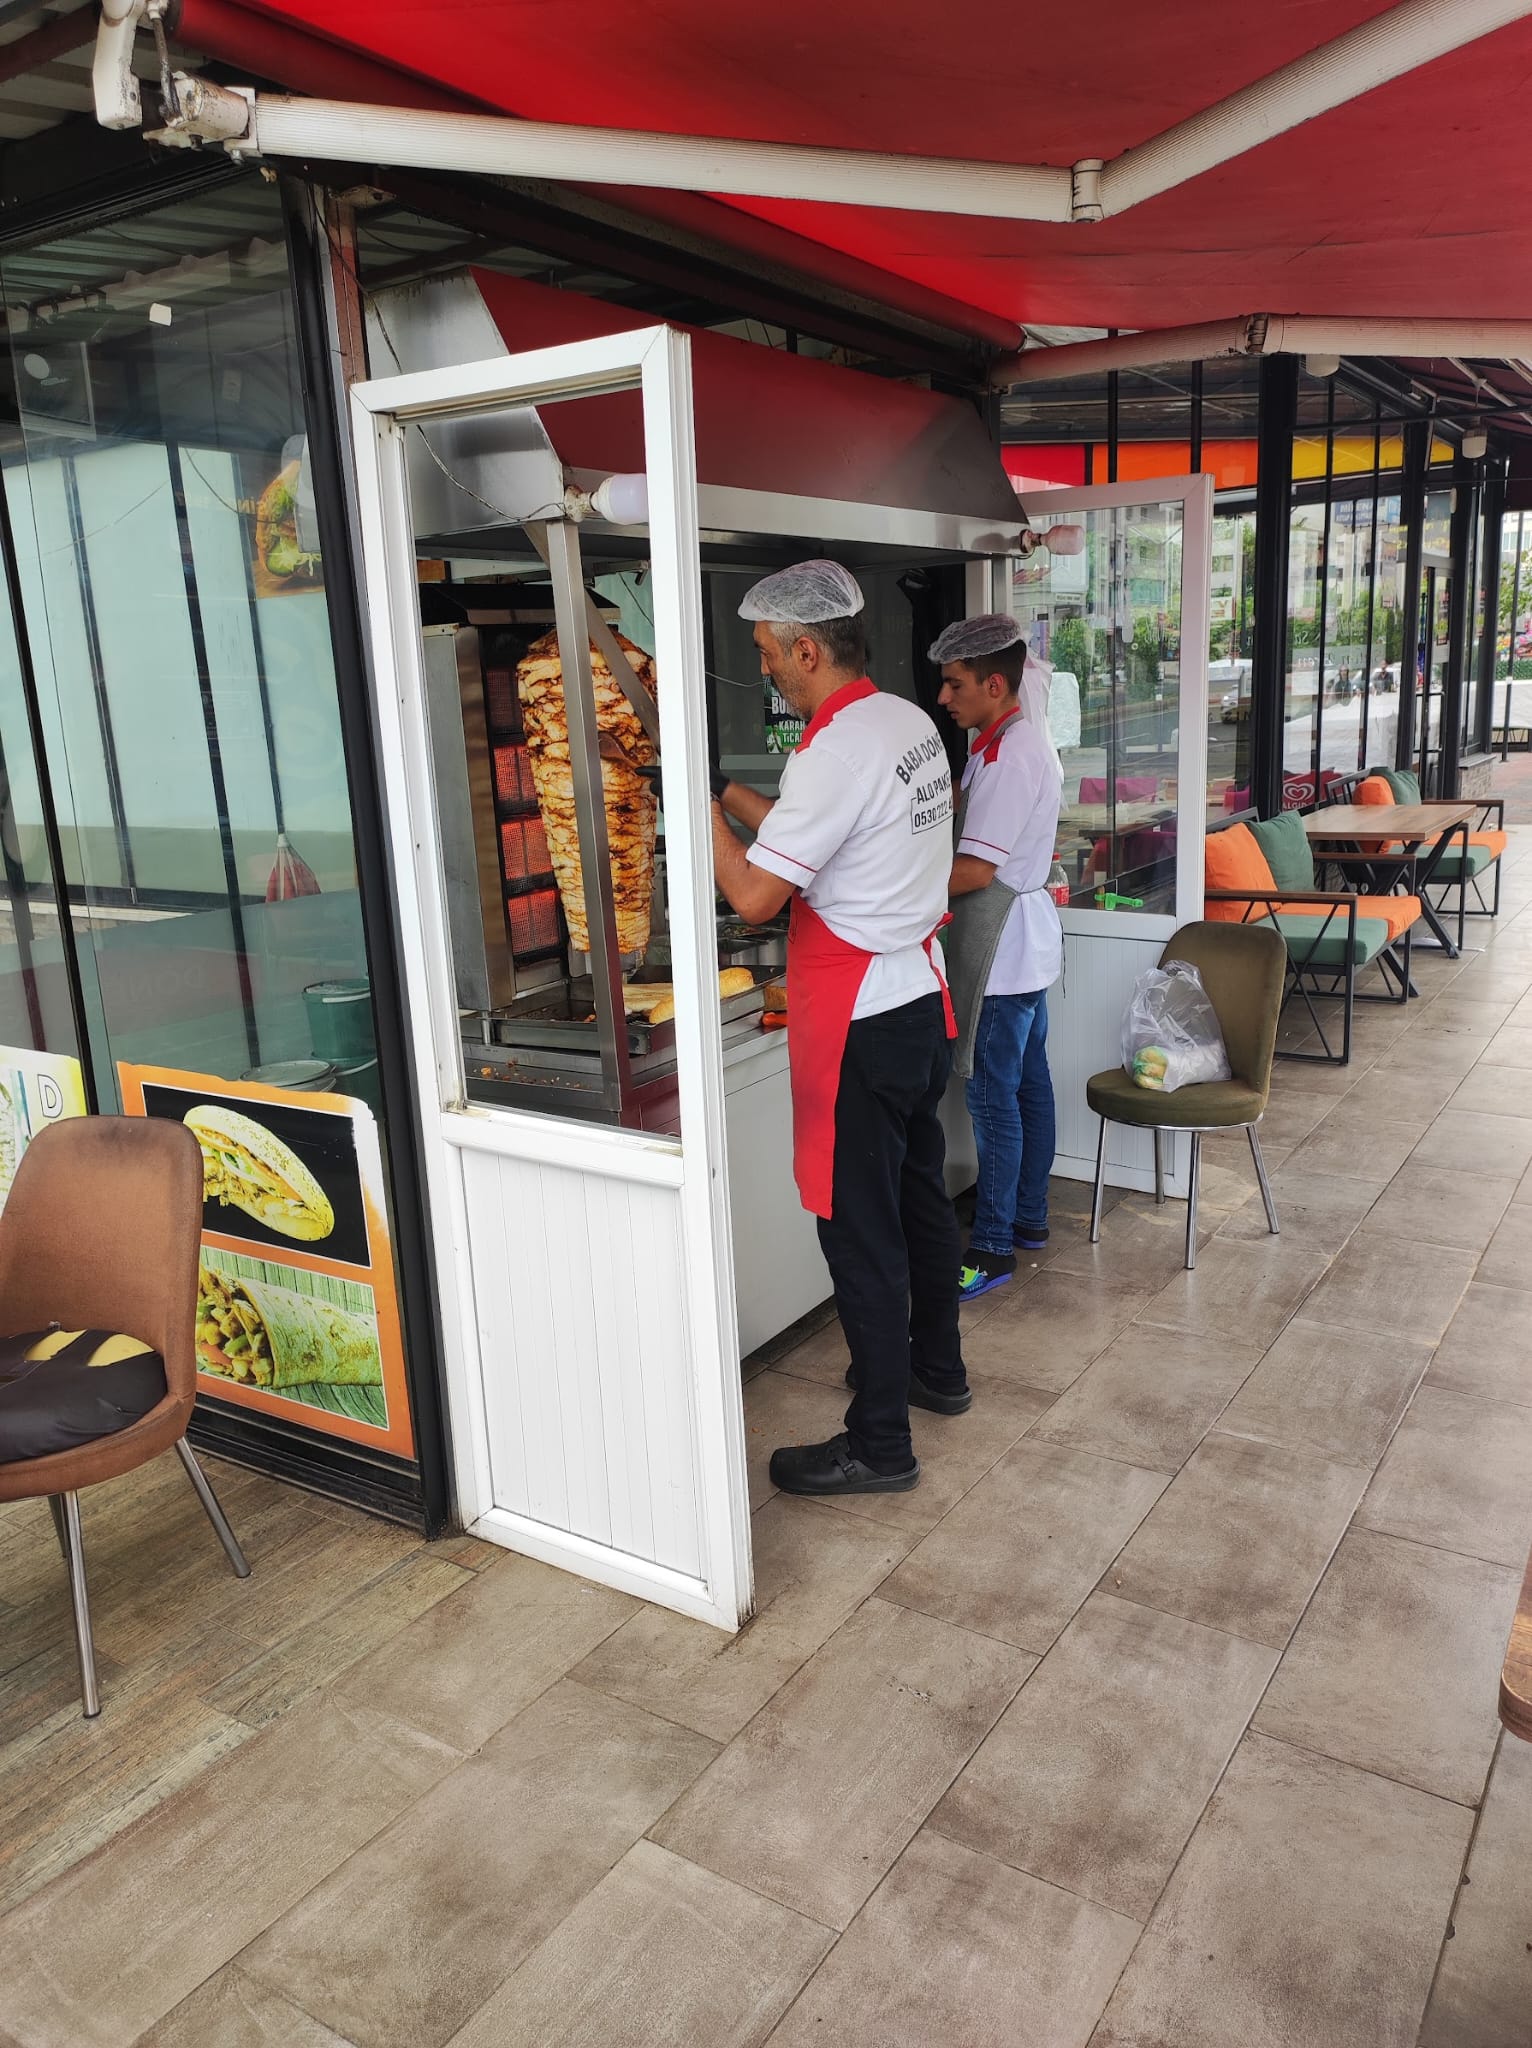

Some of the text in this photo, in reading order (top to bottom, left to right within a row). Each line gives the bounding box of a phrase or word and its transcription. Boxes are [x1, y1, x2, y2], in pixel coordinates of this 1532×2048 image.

[771, 696, 790, 714] BU
[779, 720, 806, 731] KARAH
[896, 746, 925, 785] BABA
[916, 785, 935, 805] ALO
[914, 807, 937, 828] 0530
